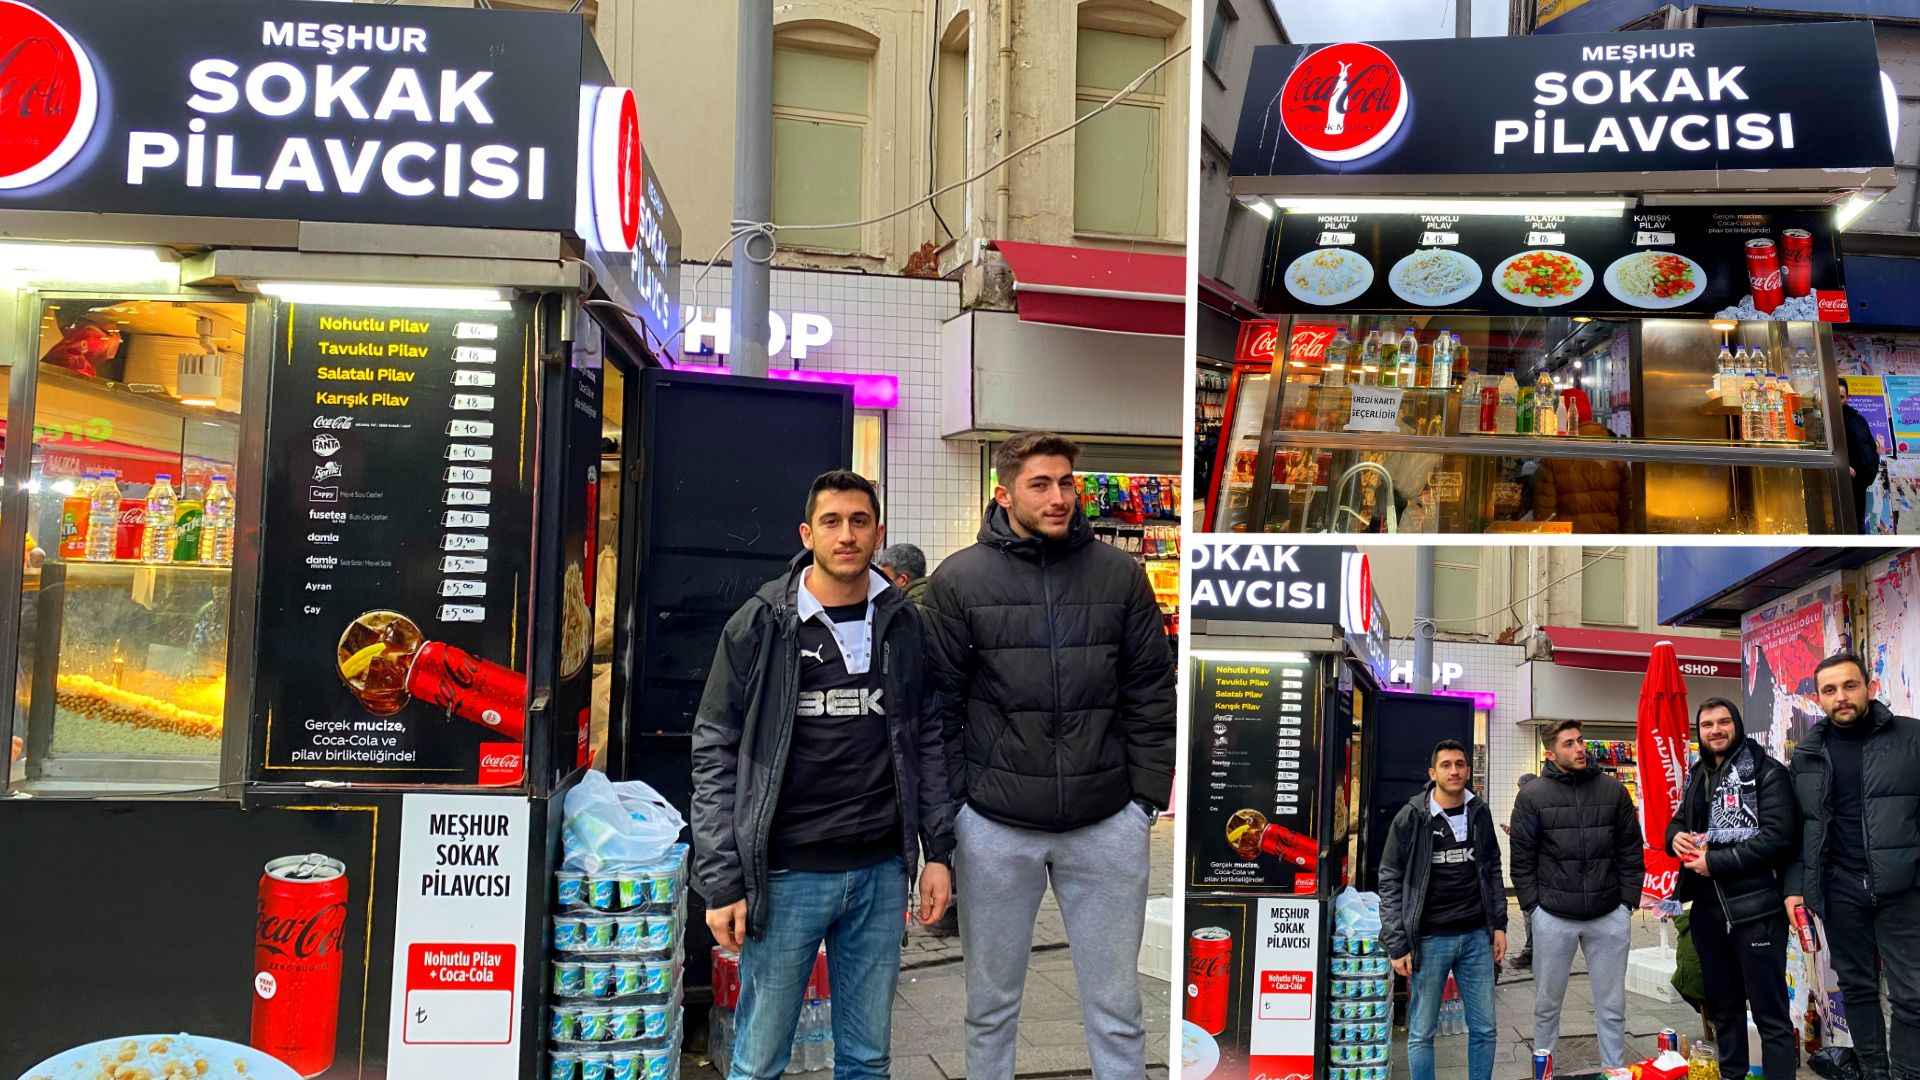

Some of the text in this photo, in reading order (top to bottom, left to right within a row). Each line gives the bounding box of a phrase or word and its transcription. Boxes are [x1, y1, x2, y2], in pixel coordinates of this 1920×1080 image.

[262, 21, 428, 55] MEŞHUR
[1582, 42, 1696, 64] MEŞHUR
[1533, 65, 1750, 106] SOKAK
[187, 59, 495, 125] SOKAK
[1493, 109, 1795, 154] PİLAVCISI
[126, 118, 545, 201] PİLAVCISI
[1318, 215, 1358, 223] NOHUTLU
[1420, 215, 1460, 223] TAVUKLU
[1524, 215, 1566, 223] SALATALI
[1633, 214, 1672, 223] KARIŞIK
[1325, 221, 1350, 230] PİLAV
[1427, 221, 1452, 230] PİLAV
[1532, 220, 1557, 229] PİLAV
[1639, 220, 1666, 229] PİLAV
[1434, 234, 1444, 244] 18
[1539, 235, 1549, 243] 18
[1648, 234, 1659, 243] 18
[319, 317, 430, 333] Nohutlu Pilav
[318, 341, 428, 358] Tavuklu Pilav
[317, 366, 415, 383] Salatalı Pilav
[316, 391, 409, 408] Karışık Pilav
[1374, 397, 1396, 405] KARTI
[313, 415, 354, 430] Coca-Cola
[464, 424, 477, 434] 10
[313, 439, 339, 450] FANTA
[463, 447, 475, 458] 10
[316, 467, 340, 479] Sprite
[462, 470, 474, 480] 10
[313, 490, 334, 498] Cappy
[461, 491, 474, 501] 10
[309, 508, 346, 520] fusetea
[461, 513, 474, 524] 10
[307, 532, 339, 542] damla
[306, 555, 338, 565] damla
[305, 582, 332, 592] Ayran
[304, 605, 321, 616] Çay
[1216, 666, 1270, 675] Nohutlu Pilav
[1684, 663, 1718, 676] SHOP
[1216, 678, 1270, 687] Tavuklu Pilav
[1245, 691, 1263, 699] Pilav
[1242, 703, 1260, 711] Pilav
[305, 719, 407, 734] Gerçek mucize,
[312, 735, 397, 747] Coca-Cola ve
[291, 749, 416, 764] pilav birlikteliğinde!
[481, 754, 521, 768] Coca-Cola
[429, 813, 509, 842] MEŞHUR
[436, 844, 499, 867] SOKAK
[1210, 861, 1233, 869] Gerçek
[421, 869, 510, 897] PİLAVCISI
[1270, 907, 1310, 922] MEŞHUR
[1274, 922, 1305, 934] SOKAK
[1267, 936, 1310, 949] PİLAVCISI
[424, 951, 501, 968] Nohutlu Pilav
[439, 967, 494, 982] Coca-Cola
[1268, 974, 1306, 983] Nohutlu Pilav
[1276, 982, 1303, 991] Coca-Cola
